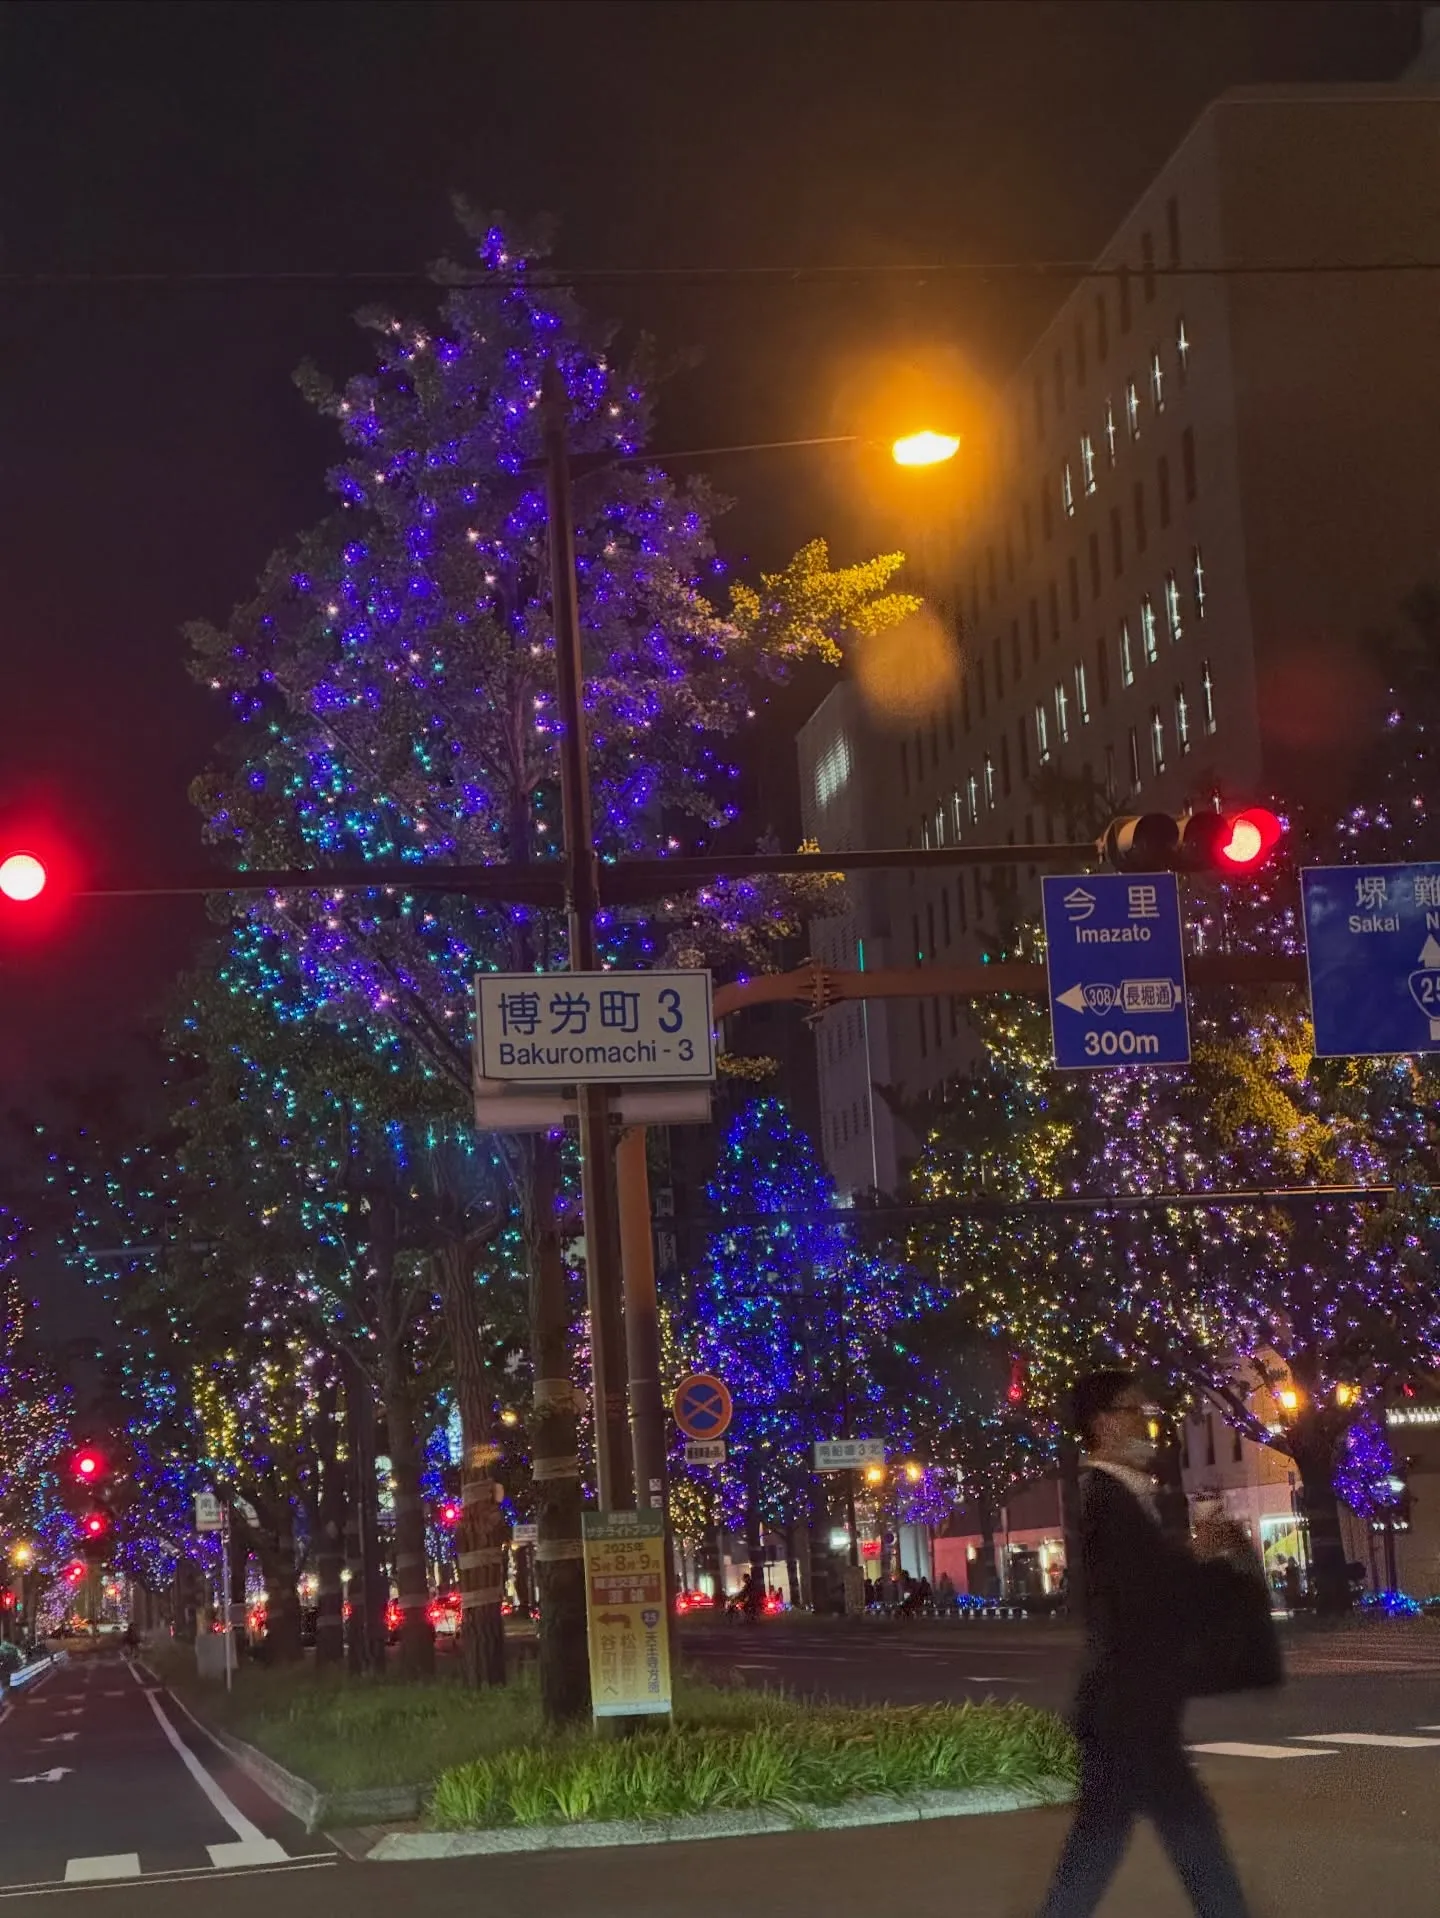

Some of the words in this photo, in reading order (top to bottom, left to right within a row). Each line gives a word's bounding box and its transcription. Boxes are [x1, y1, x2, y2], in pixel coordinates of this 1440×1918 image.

[1063, 884, 1160, 922] 今里
[1355, 876, 1387, 910] 堺
[1075, 925, 1152, 944] Imazato
[1348, 914, 1401, 935] Sakai
[1088, 988, 1111, 1007] 308
[1125, 984, 1171, 1009] 長堀通
[1084, 1029, 1160, 1058] 300m
